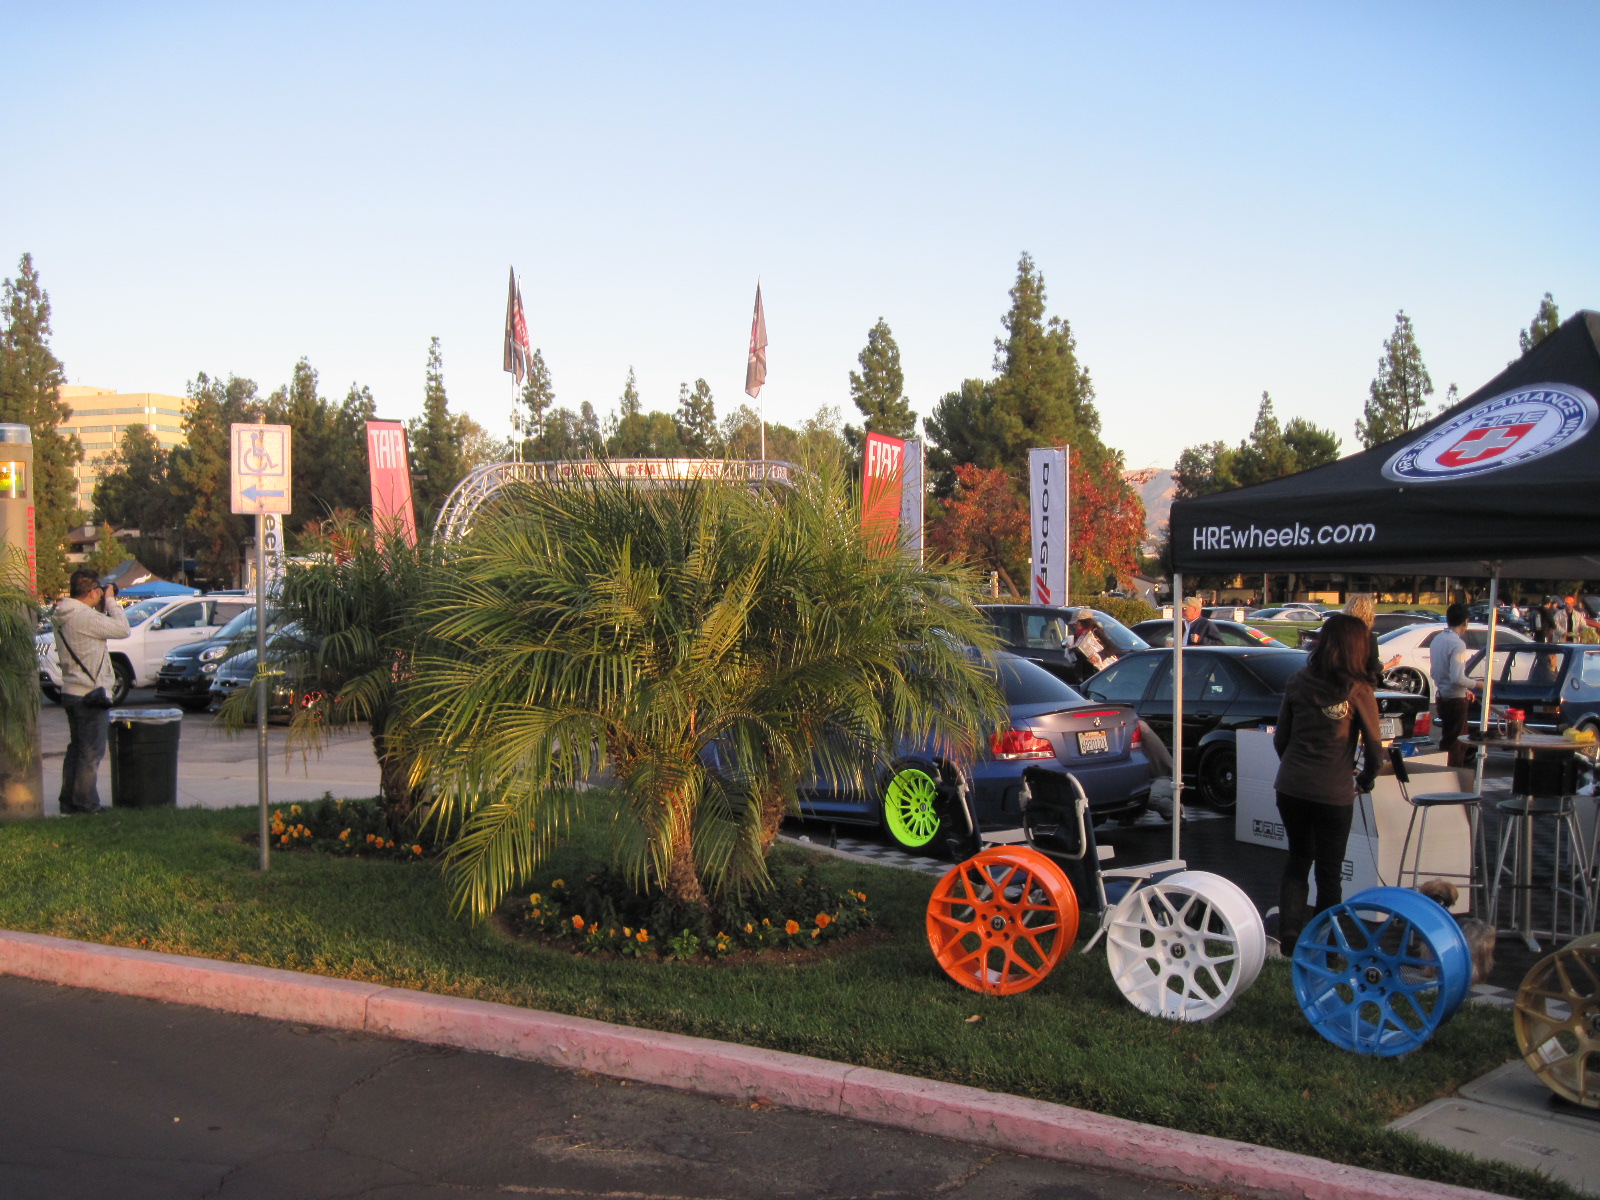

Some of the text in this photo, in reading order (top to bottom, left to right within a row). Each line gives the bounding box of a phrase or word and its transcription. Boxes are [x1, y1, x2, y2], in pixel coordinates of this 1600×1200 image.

[1473, 410, 1548, 429] HRE
[868, 440, 901, 481] FIAT
[1040, 462, 1050, 588] DODGE
[1193, 522, 1376, 550] HREwheels.com
[1252, 819, 1285, 837] HRE
